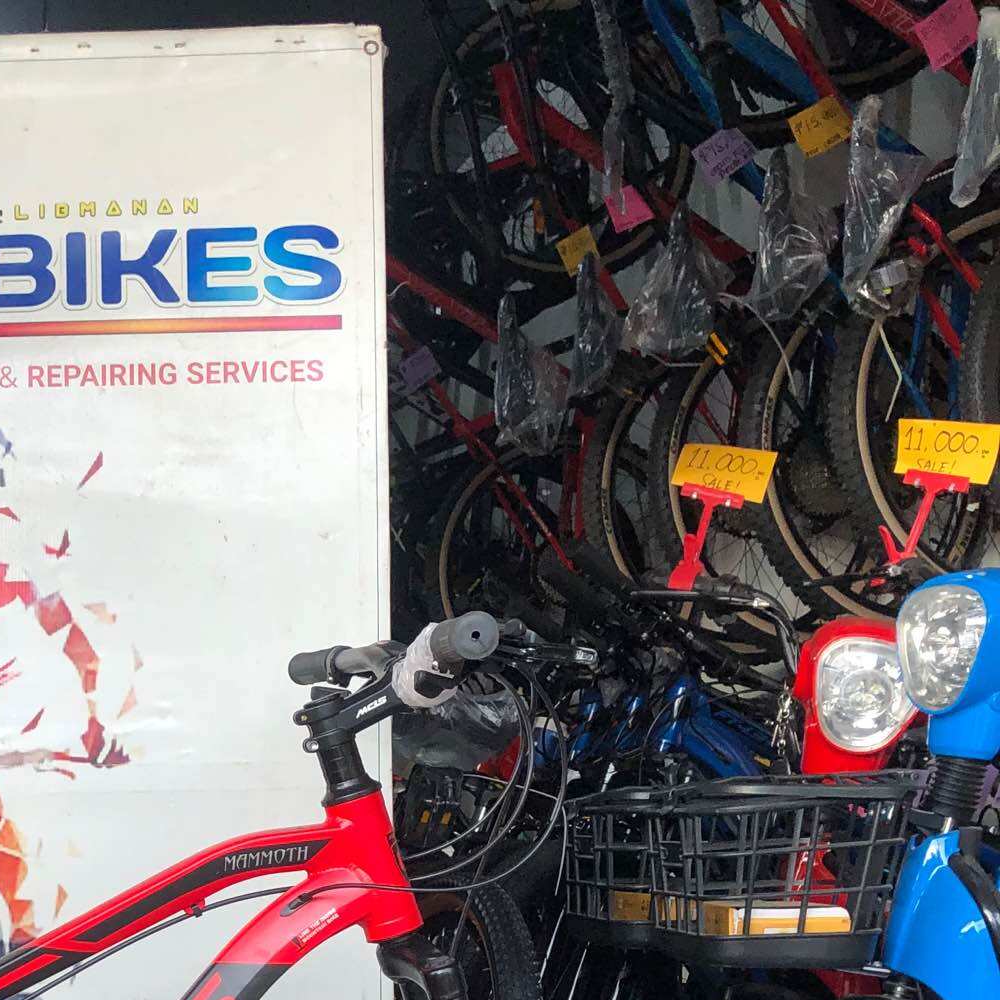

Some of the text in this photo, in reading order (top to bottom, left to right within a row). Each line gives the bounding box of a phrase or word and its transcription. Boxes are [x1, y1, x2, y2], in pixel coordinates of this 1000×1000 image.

[13, 197, 199, 221] LIBMANAN
[0, 365, 18, 388] &
[28, 361, 178, 388] REPAIRING
[186, 359, 325, 384] SERVICES
[224, 846, 309, 872] MAMMOTH
